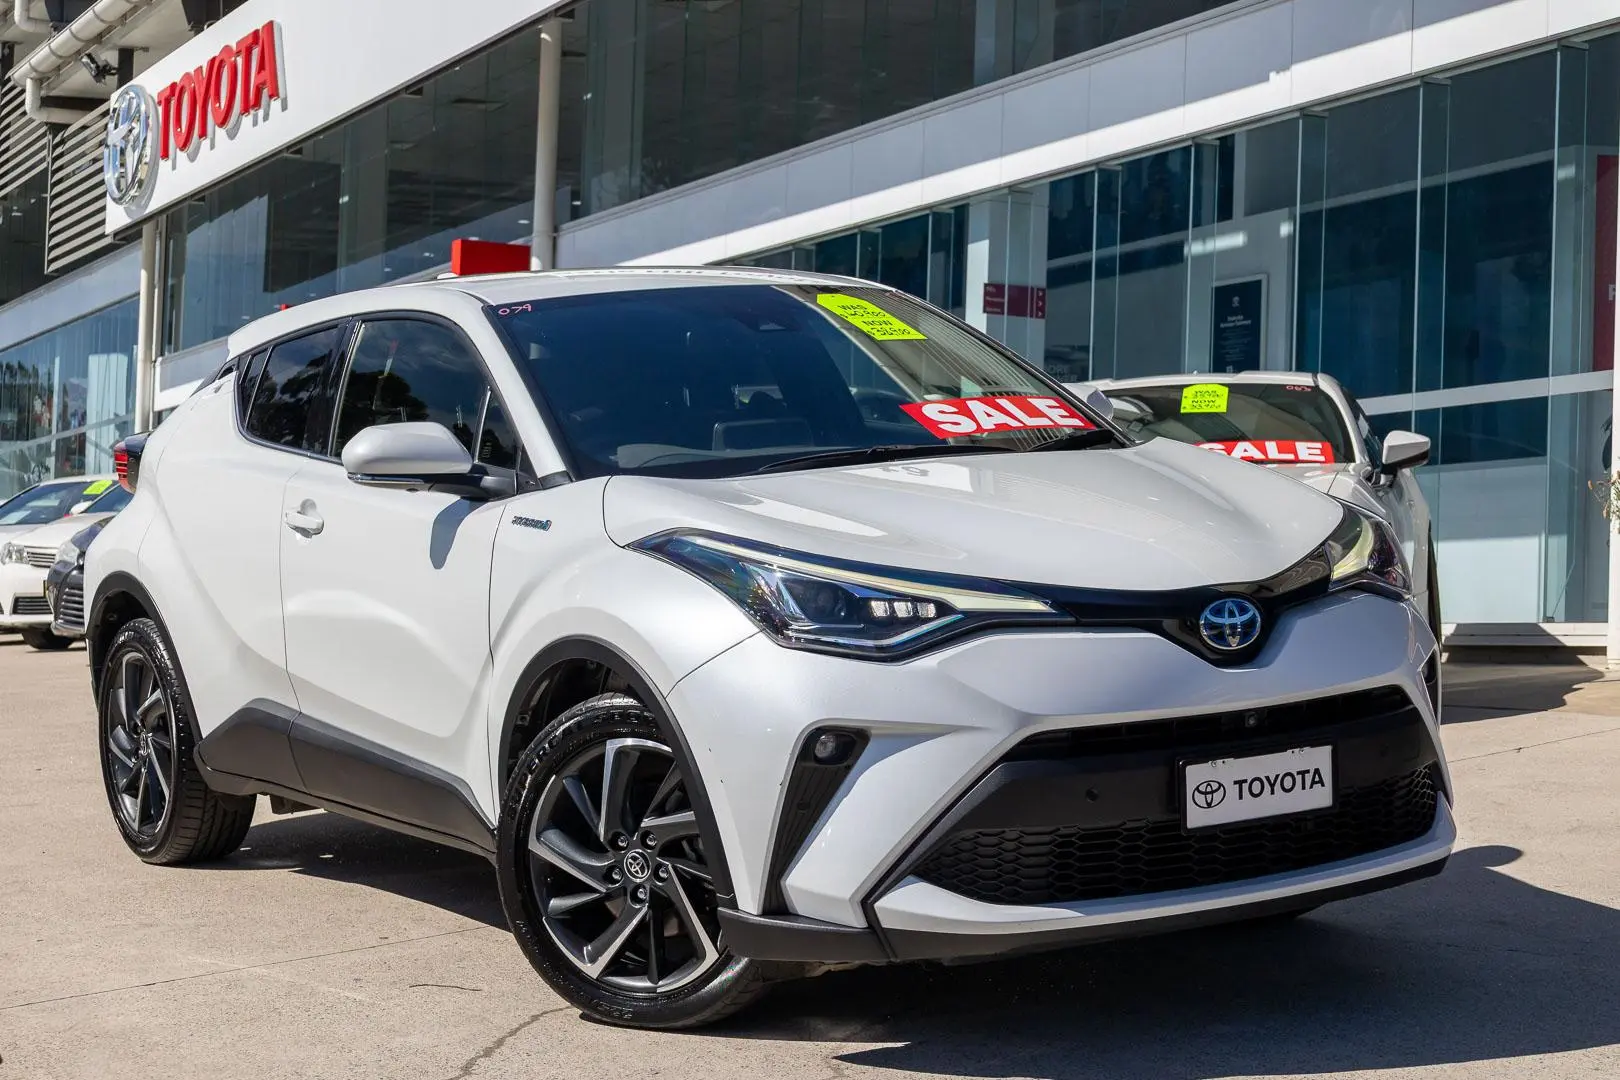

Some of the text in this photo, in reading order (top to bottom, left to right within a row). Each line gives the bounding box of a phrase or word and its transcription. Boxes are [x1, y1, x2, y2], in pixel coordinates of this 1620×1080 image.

[157, 20, 280, 161] TOYOTA
[861, 319, 894, 327] NOW
[921, 398, 1085, 434] SALE
[1233, 767, 1326, 801] TOYOTA
